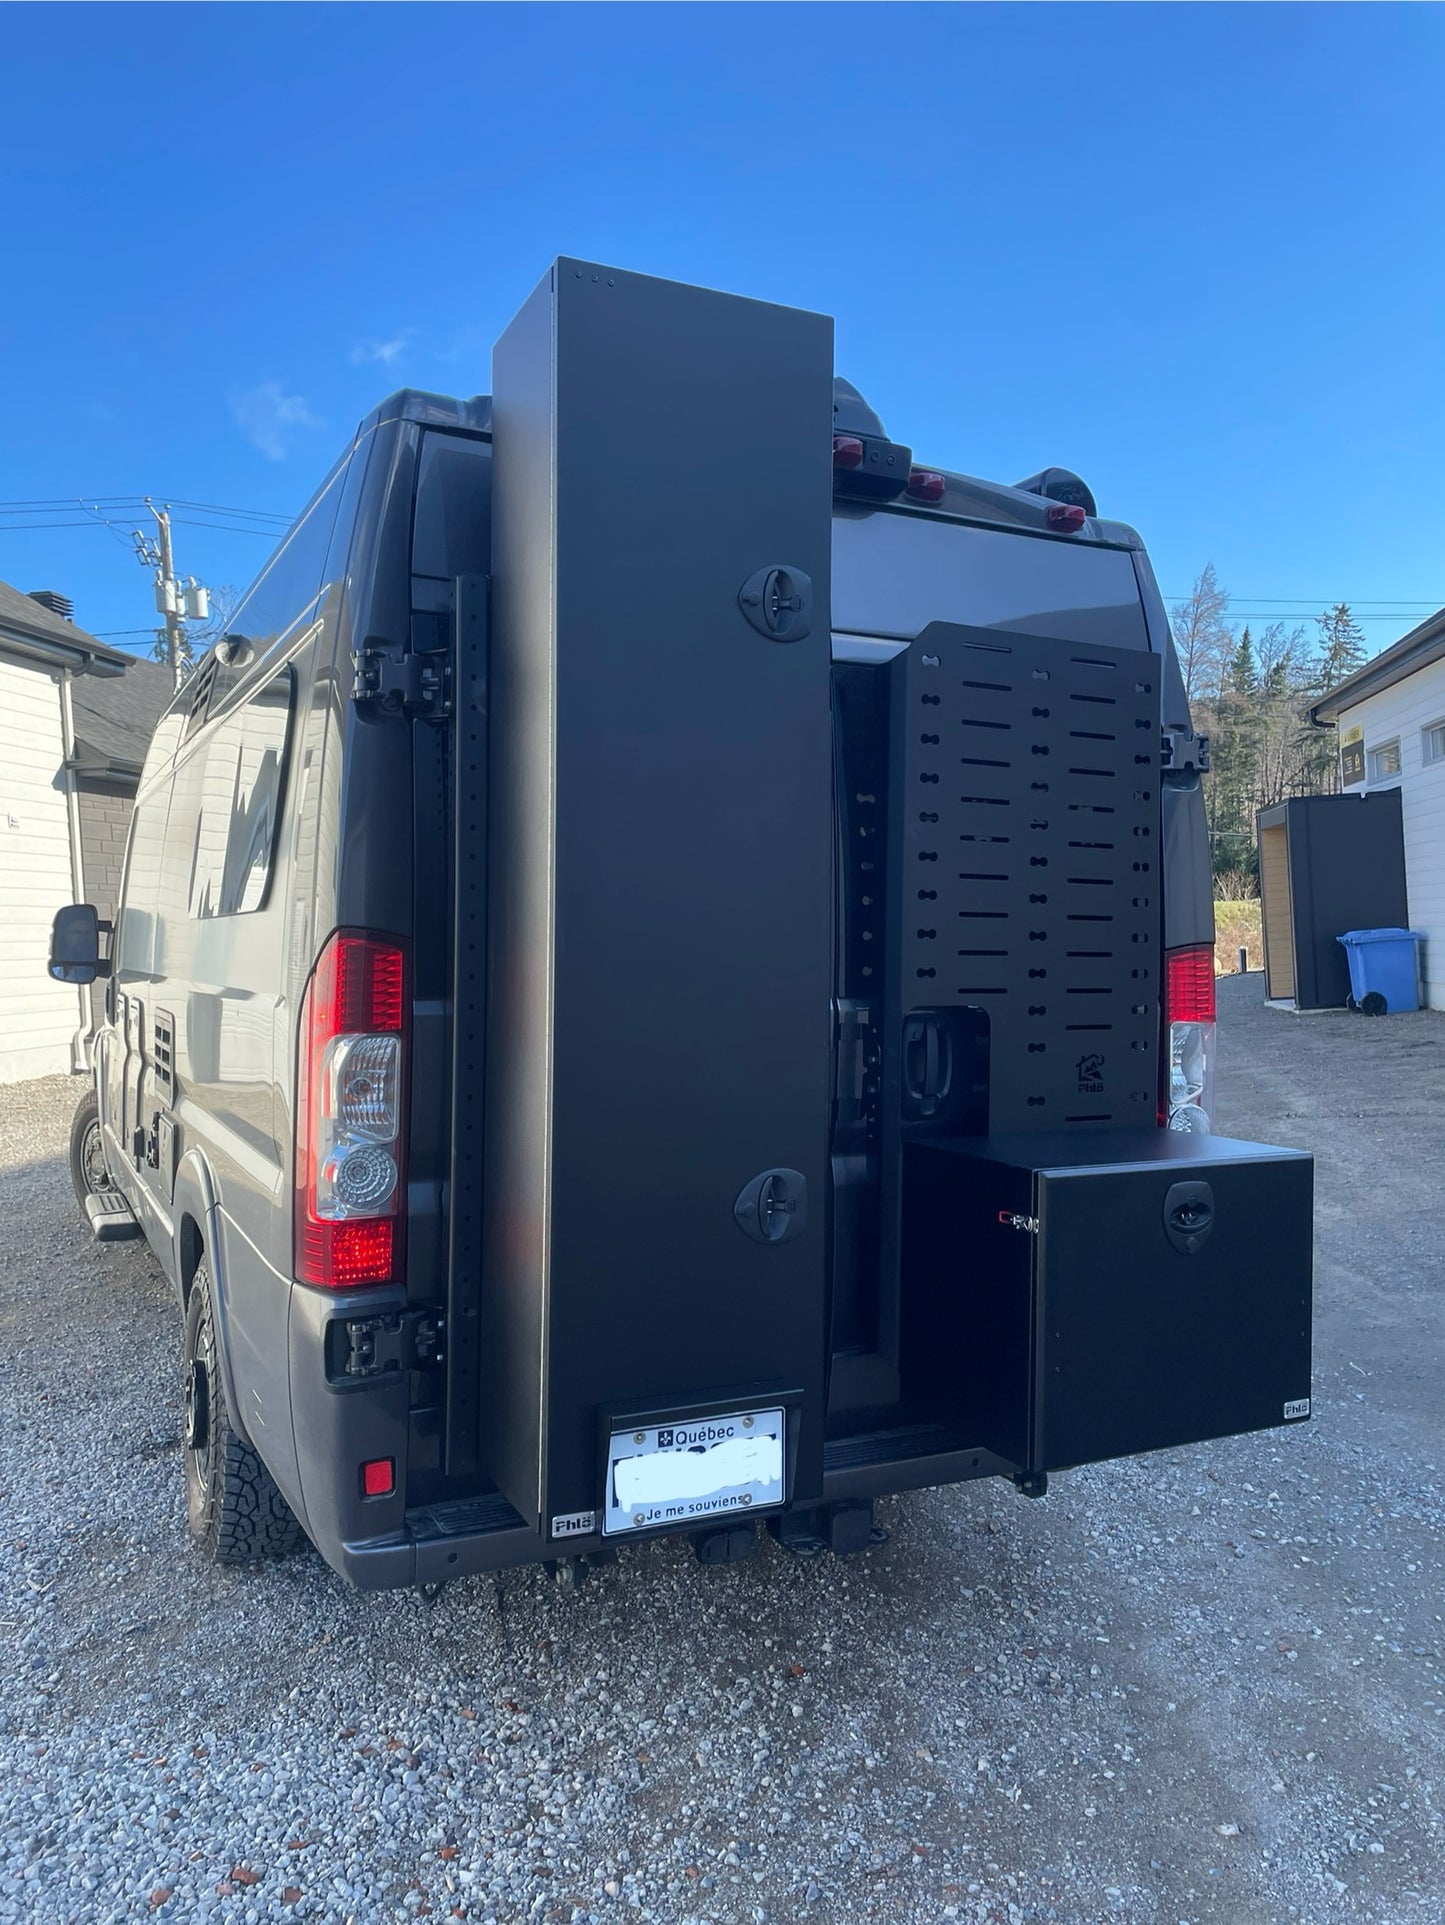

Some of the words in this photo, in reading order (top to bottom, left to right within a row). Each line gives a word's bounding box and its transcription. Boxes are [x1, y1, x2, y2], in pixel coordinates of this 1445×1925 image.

[675, 1426, 735, 1445] Québec
[646, 1508, 661, 1520] Je
[666, 1505, 684, 1517] me
